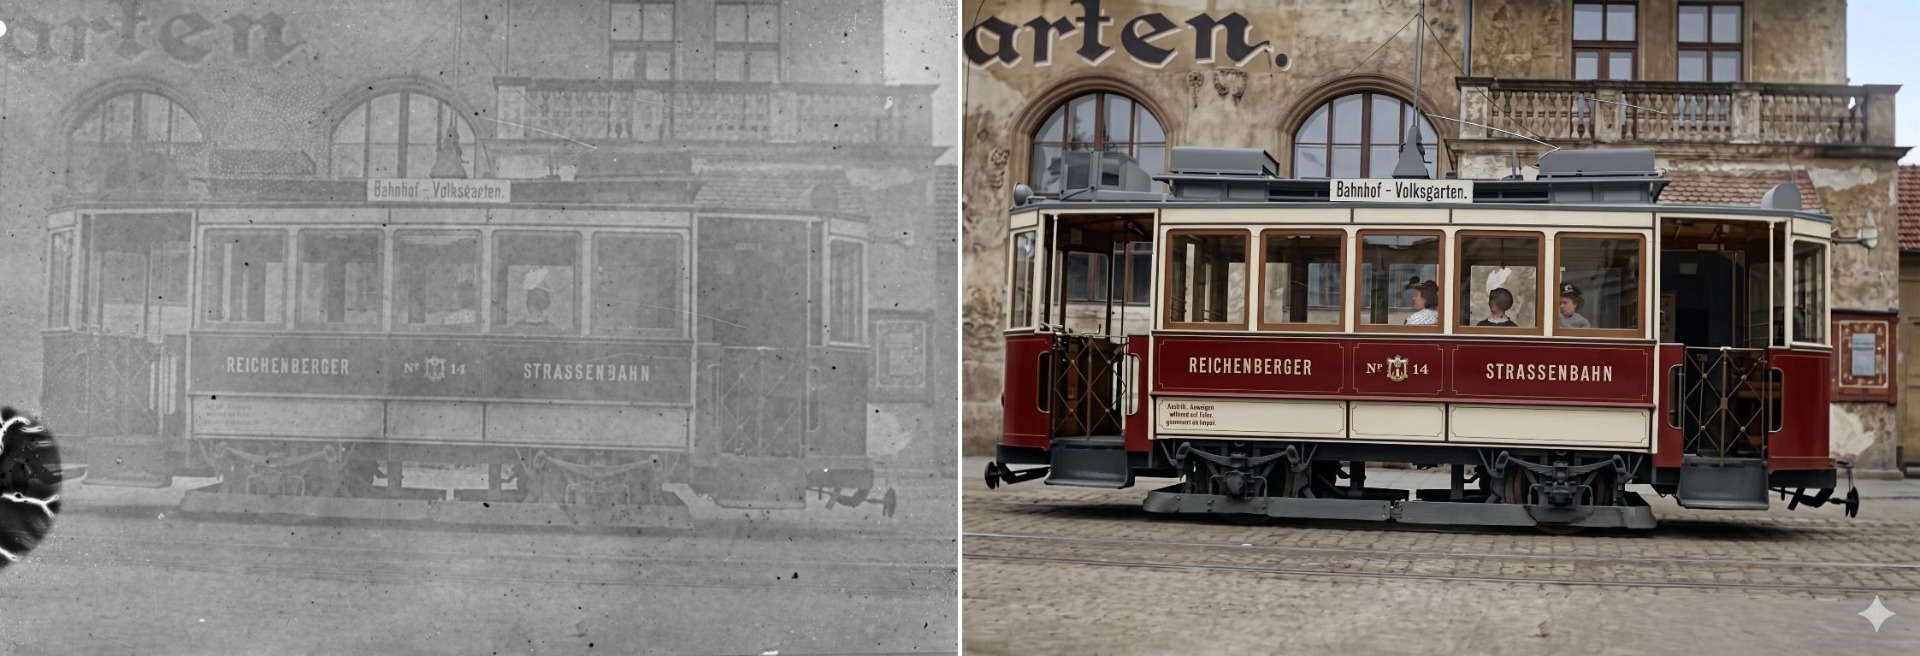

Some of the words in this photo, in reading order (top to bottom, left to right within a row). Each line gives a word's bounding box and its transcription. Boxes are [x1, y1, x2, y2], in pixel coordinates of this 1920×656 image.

[963, 0, 1292, 70] arten.
[374, 180, 420, 198] Bahnhof
[432, 181, 505, 200] Volksgarten.
[1336, 181, 1382, 198] Bahnhof
[1396, 181, 1468, 201] Volksgarten.
[226, 356, 349, 375] REICHENBERGER
[450, 363, 467, 375] 14
[523, 362, 650, 382] STRASSENBAHN
[1189, 357, 1312, 375] REICHENBERGER
[1413, 363, 1429, 375] 14
[1486, 363, 1612, 382] STRASSENBAHN
